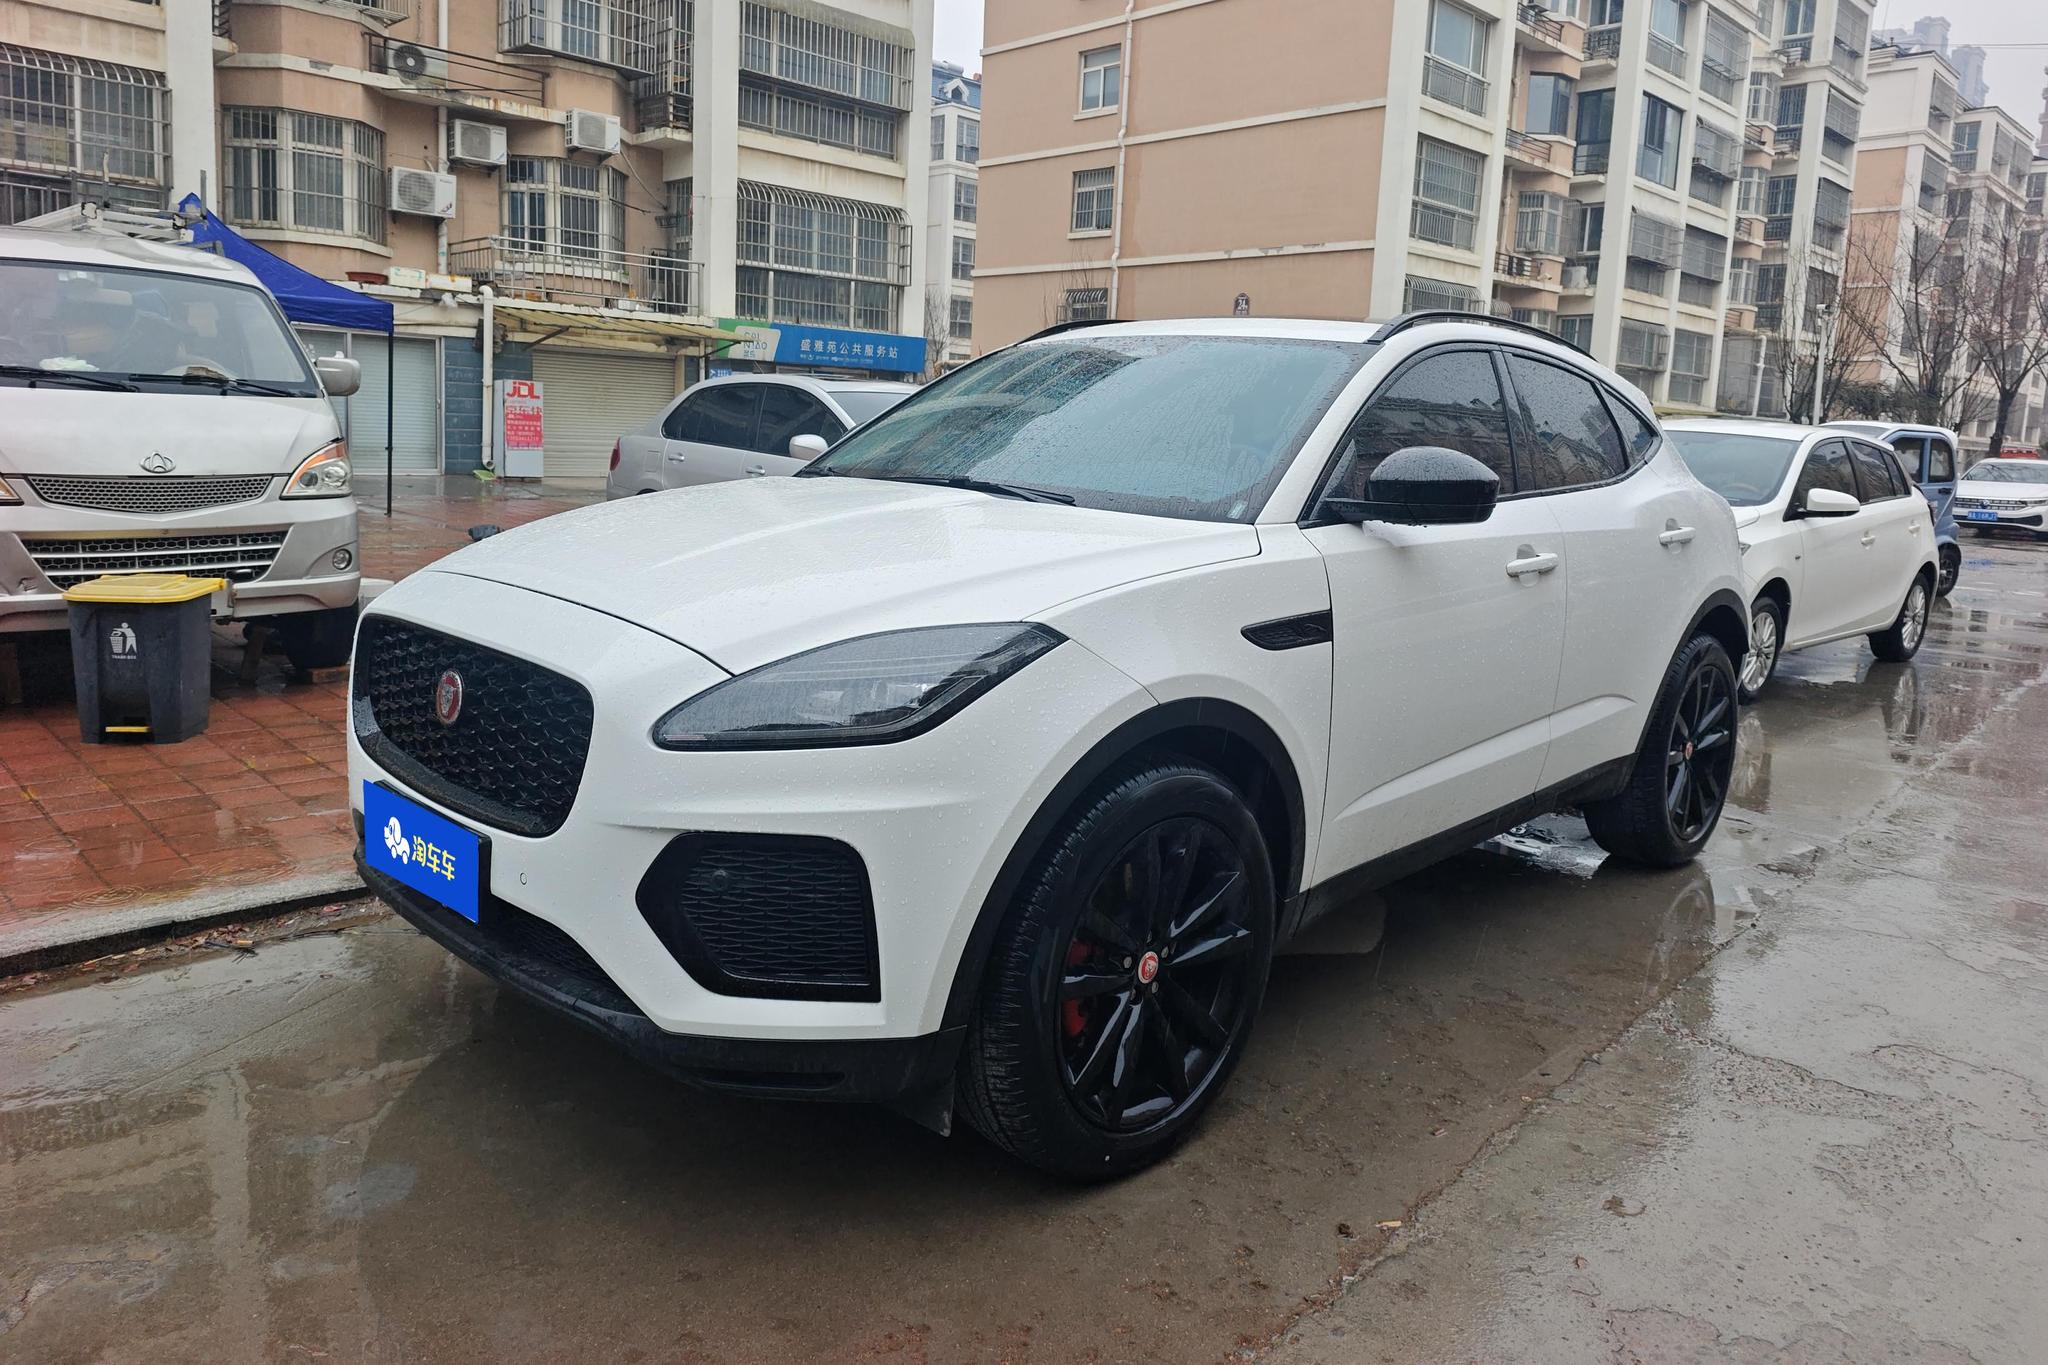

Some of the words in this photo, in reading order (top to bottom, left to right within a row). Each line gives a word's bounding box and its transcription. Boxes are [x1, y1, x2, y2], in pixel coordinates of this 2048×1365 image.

[800, 338, 899, 359] 盛雅苑公共服务站
[506, 381, 541, 400] JDL
